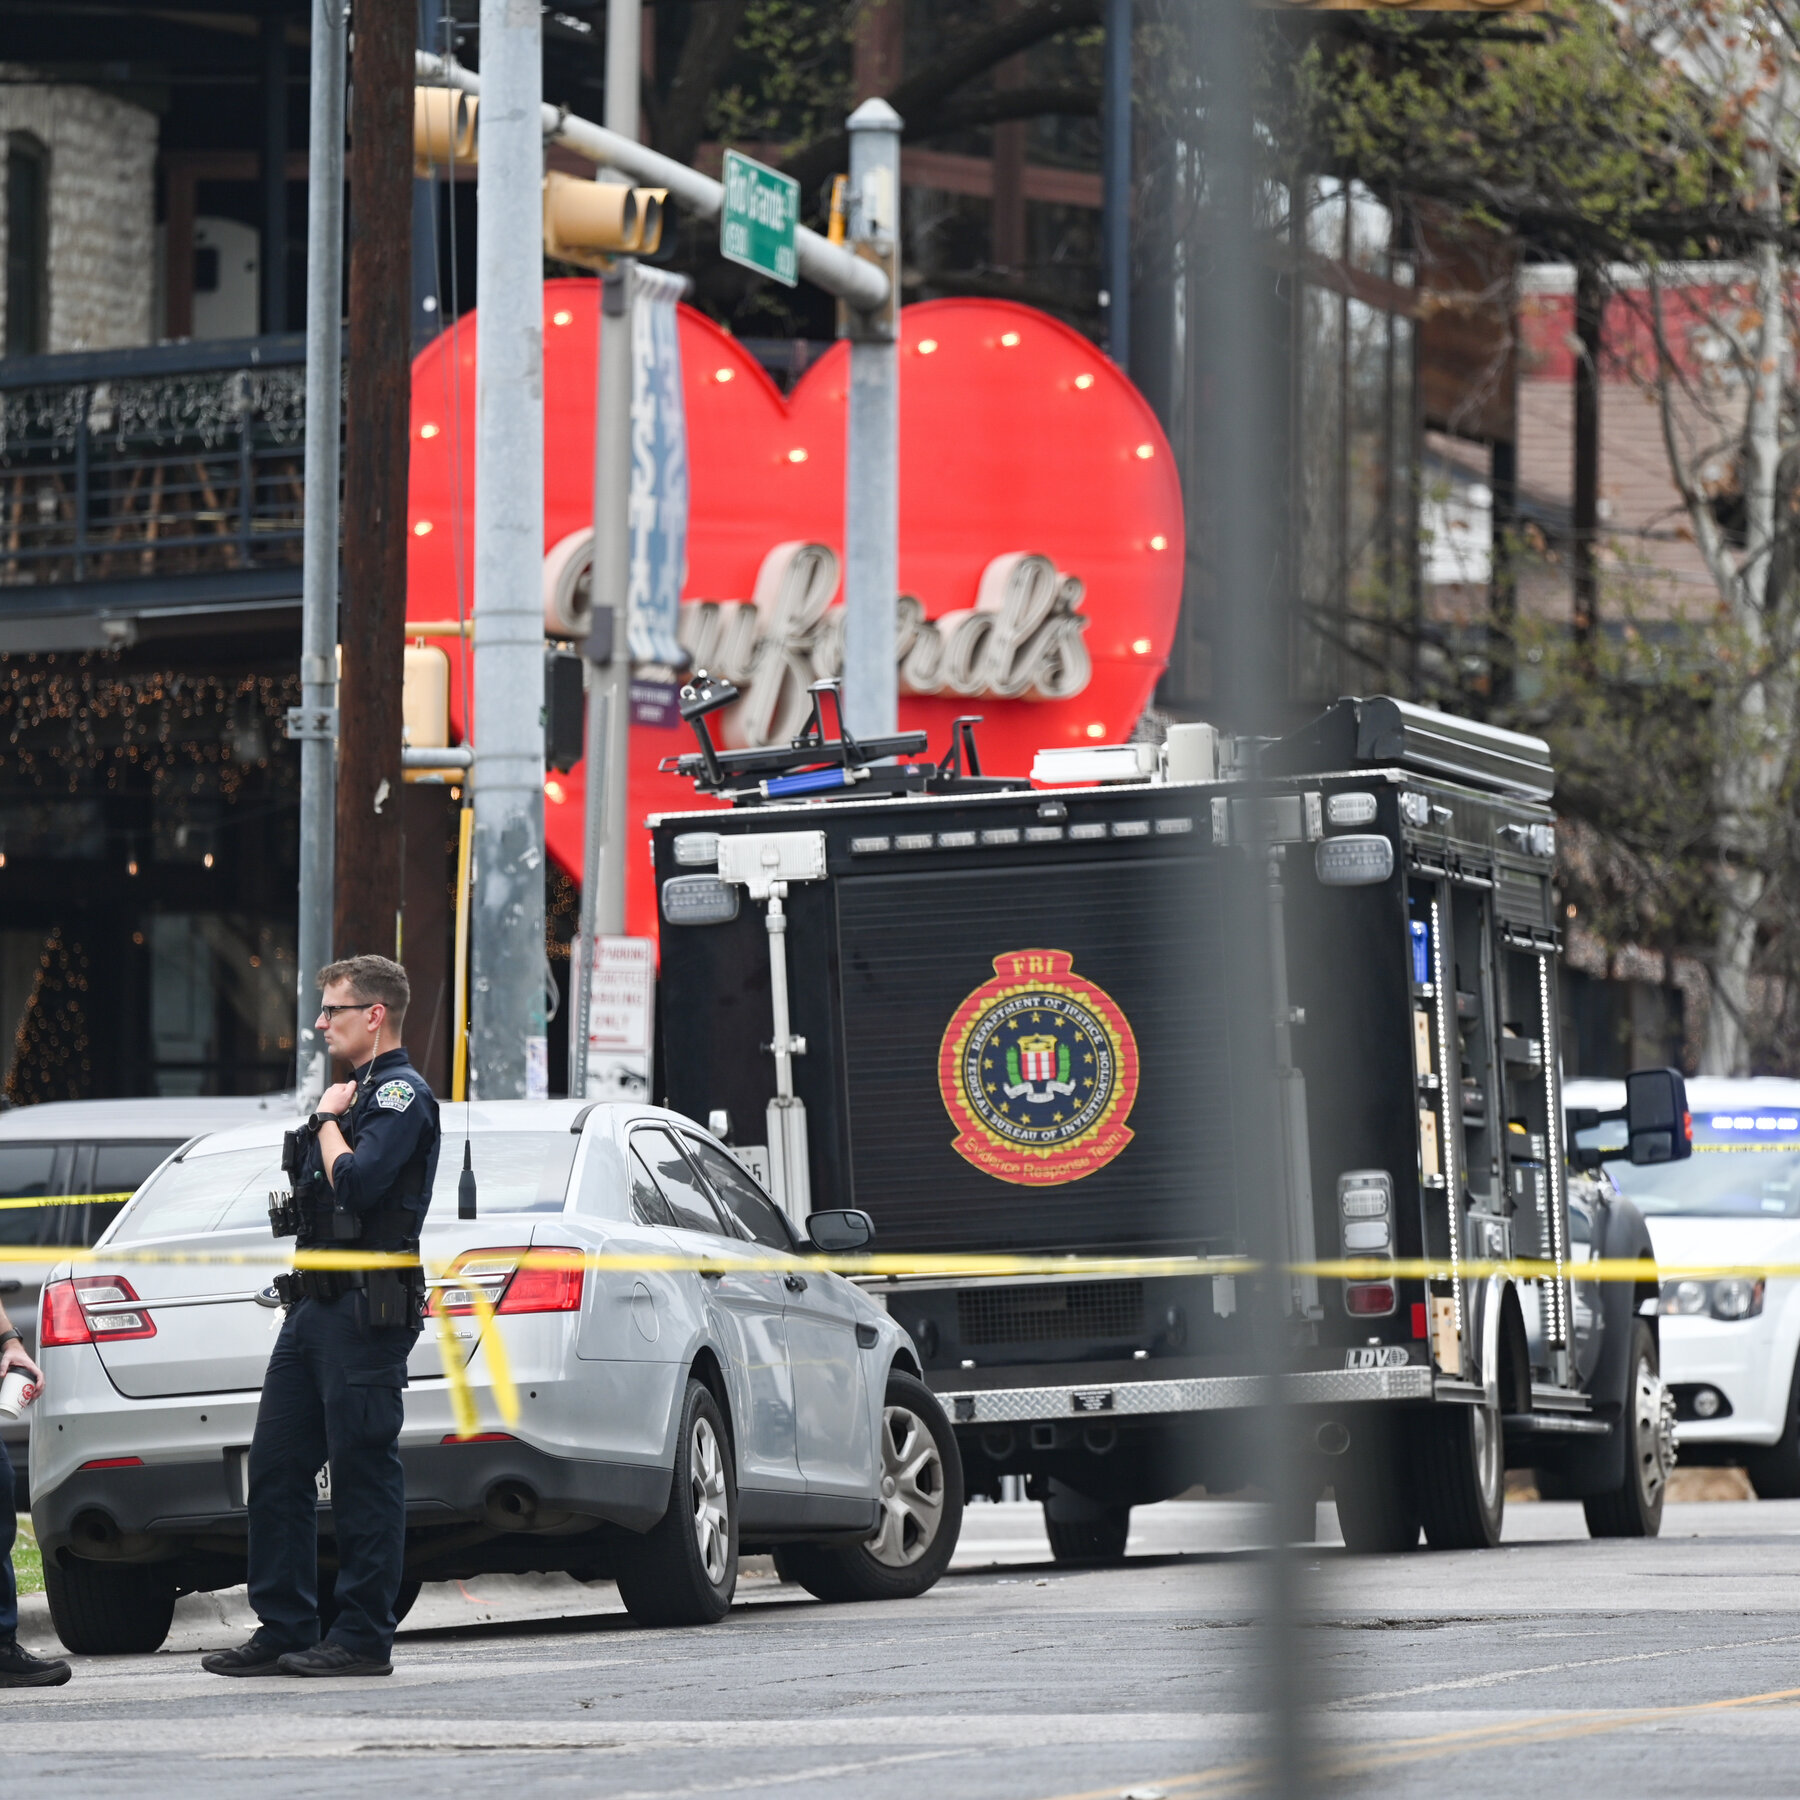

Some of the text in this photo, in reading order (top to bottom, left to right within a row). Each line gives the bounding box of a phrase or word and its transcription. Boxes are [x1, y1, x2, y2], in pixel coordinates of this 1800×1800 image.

[1012, 955, 1055, 976] FBI
[971, 997, 1103, 1051] DEPARTMENT OF JUSTICE
[379, 1081, 414, 1095] POLICE
[967, 1057, 991, 1117] FEDERAL
[990, 1114, 1038, 1142] BUREAU
[1040, 1130, 1056, 1142] OF
[1061, 1050, 1111, 1137] INVESTIGATION
[963, 1130, 1123, 1179] Evidence Response Team
[1346, 1348, 1391, 1369] LDV
